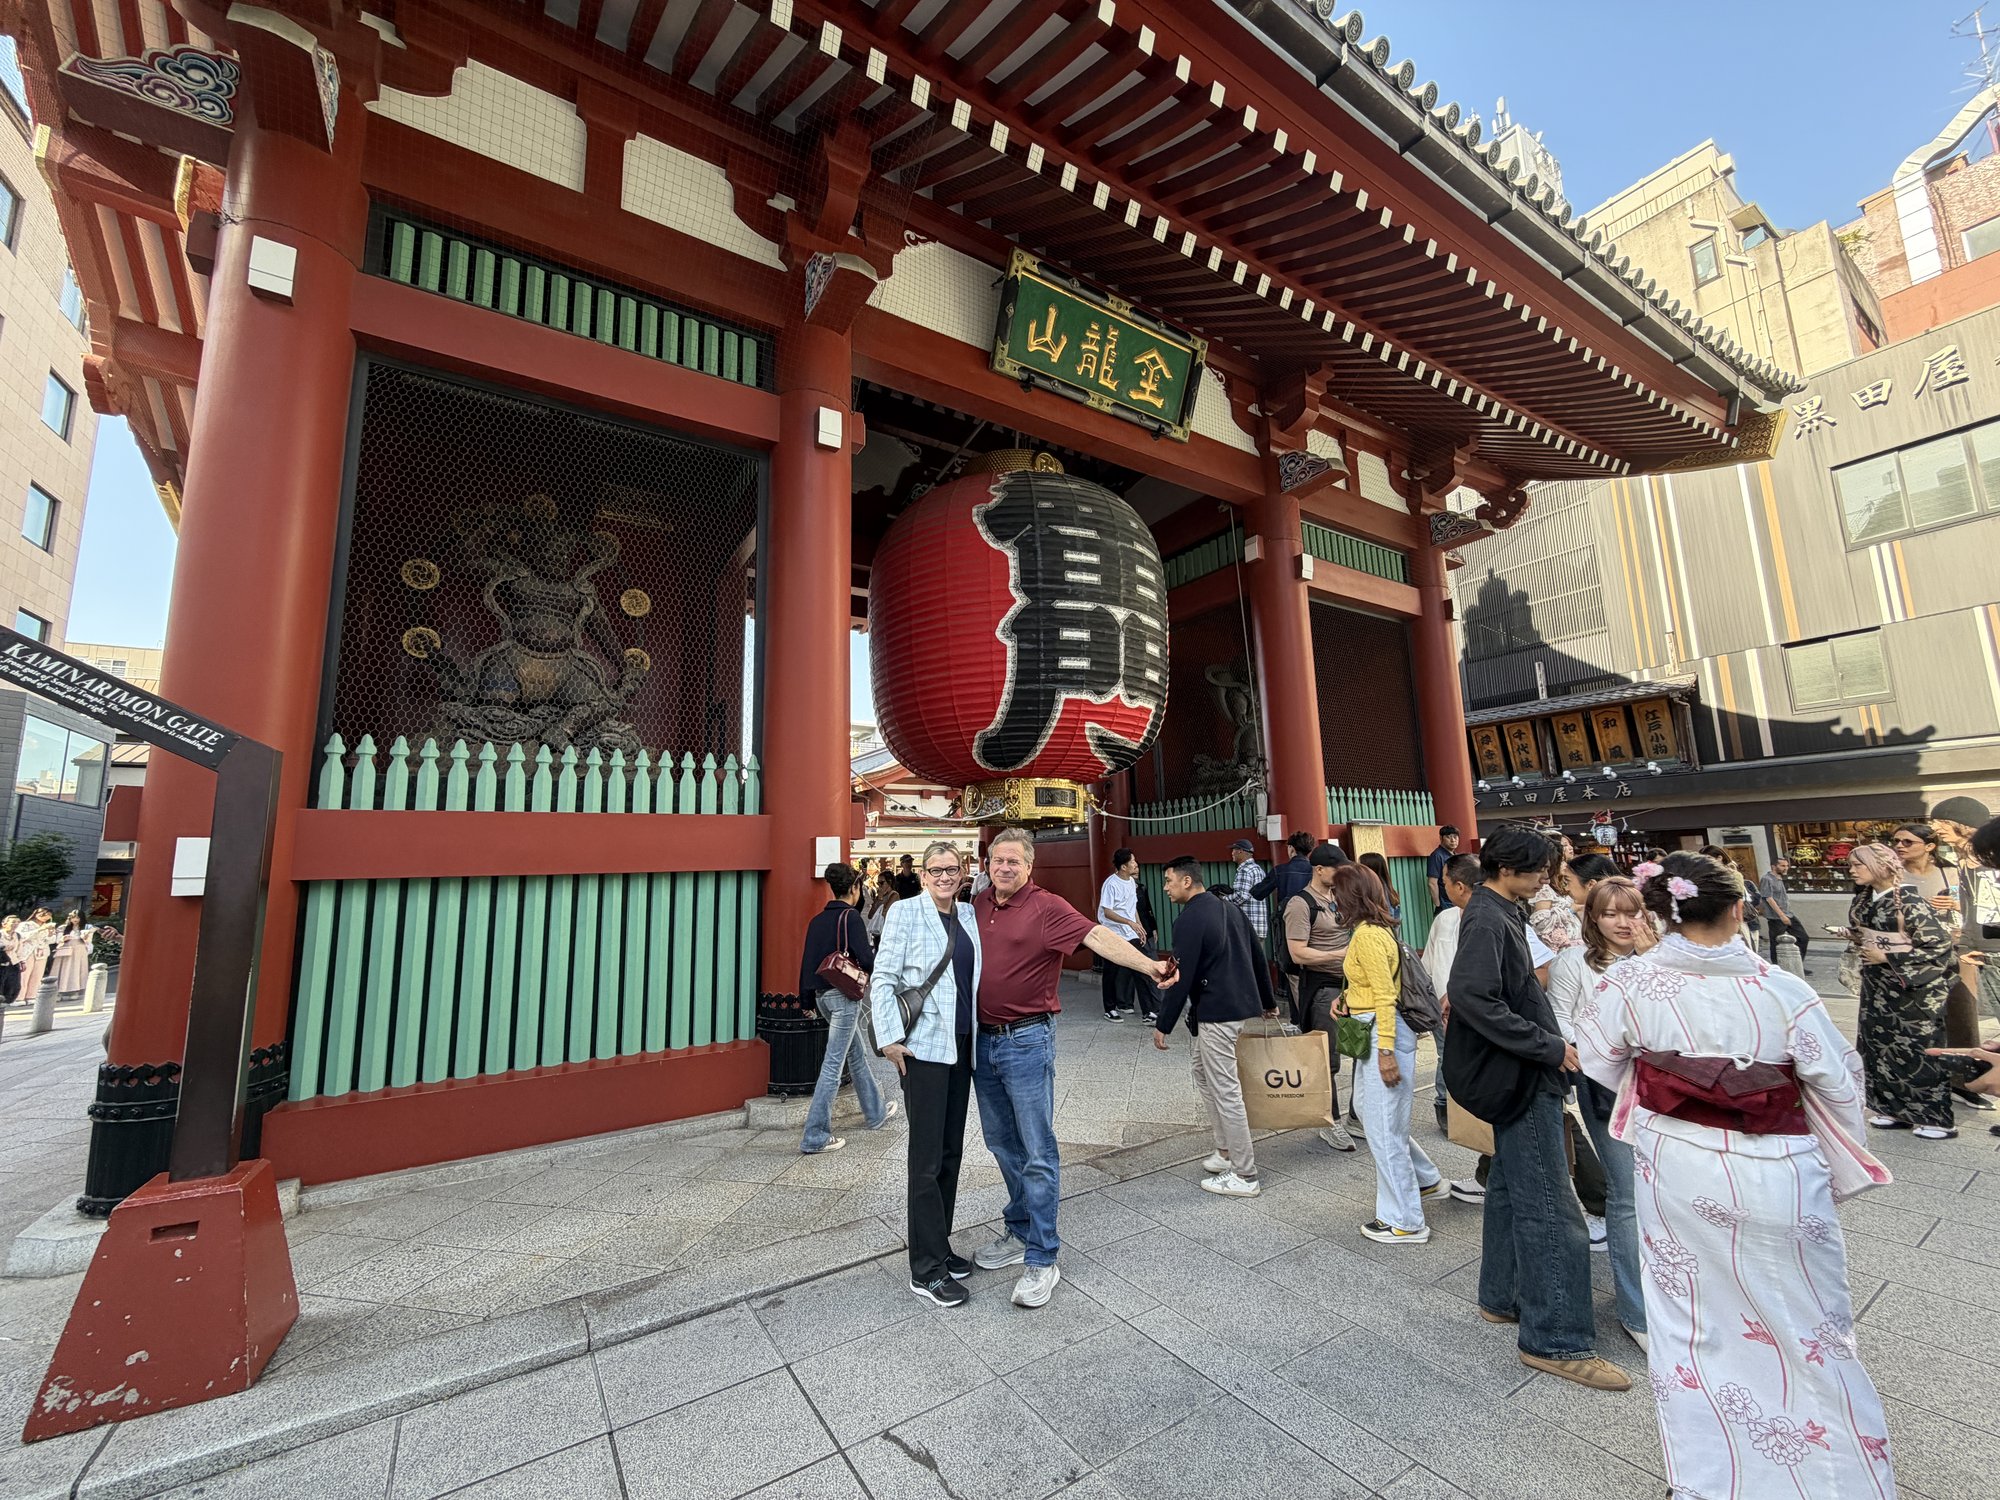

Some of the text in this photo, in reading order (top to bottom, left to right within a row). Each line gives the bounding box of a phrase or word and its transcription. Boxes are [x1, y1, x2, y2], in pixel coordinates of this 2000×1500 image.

[1791, 344, 2000, 440] 黒田屋
[1, 642, 225, 746] KAMINARIMON GATE
[36, 681, 50, 689] of
[41, 672, 53, 681] of
[106, 701, 122, 713] The
[134, 714, 145, 723] of
[142, 718, 170, 733] thunder
[175, 733, 206, 751] standing
[204, 746, 214, 754] on
[1499, 781, 1633, 807] 黒田屋本店
[1264, 1069, 1302, 1089] GU
